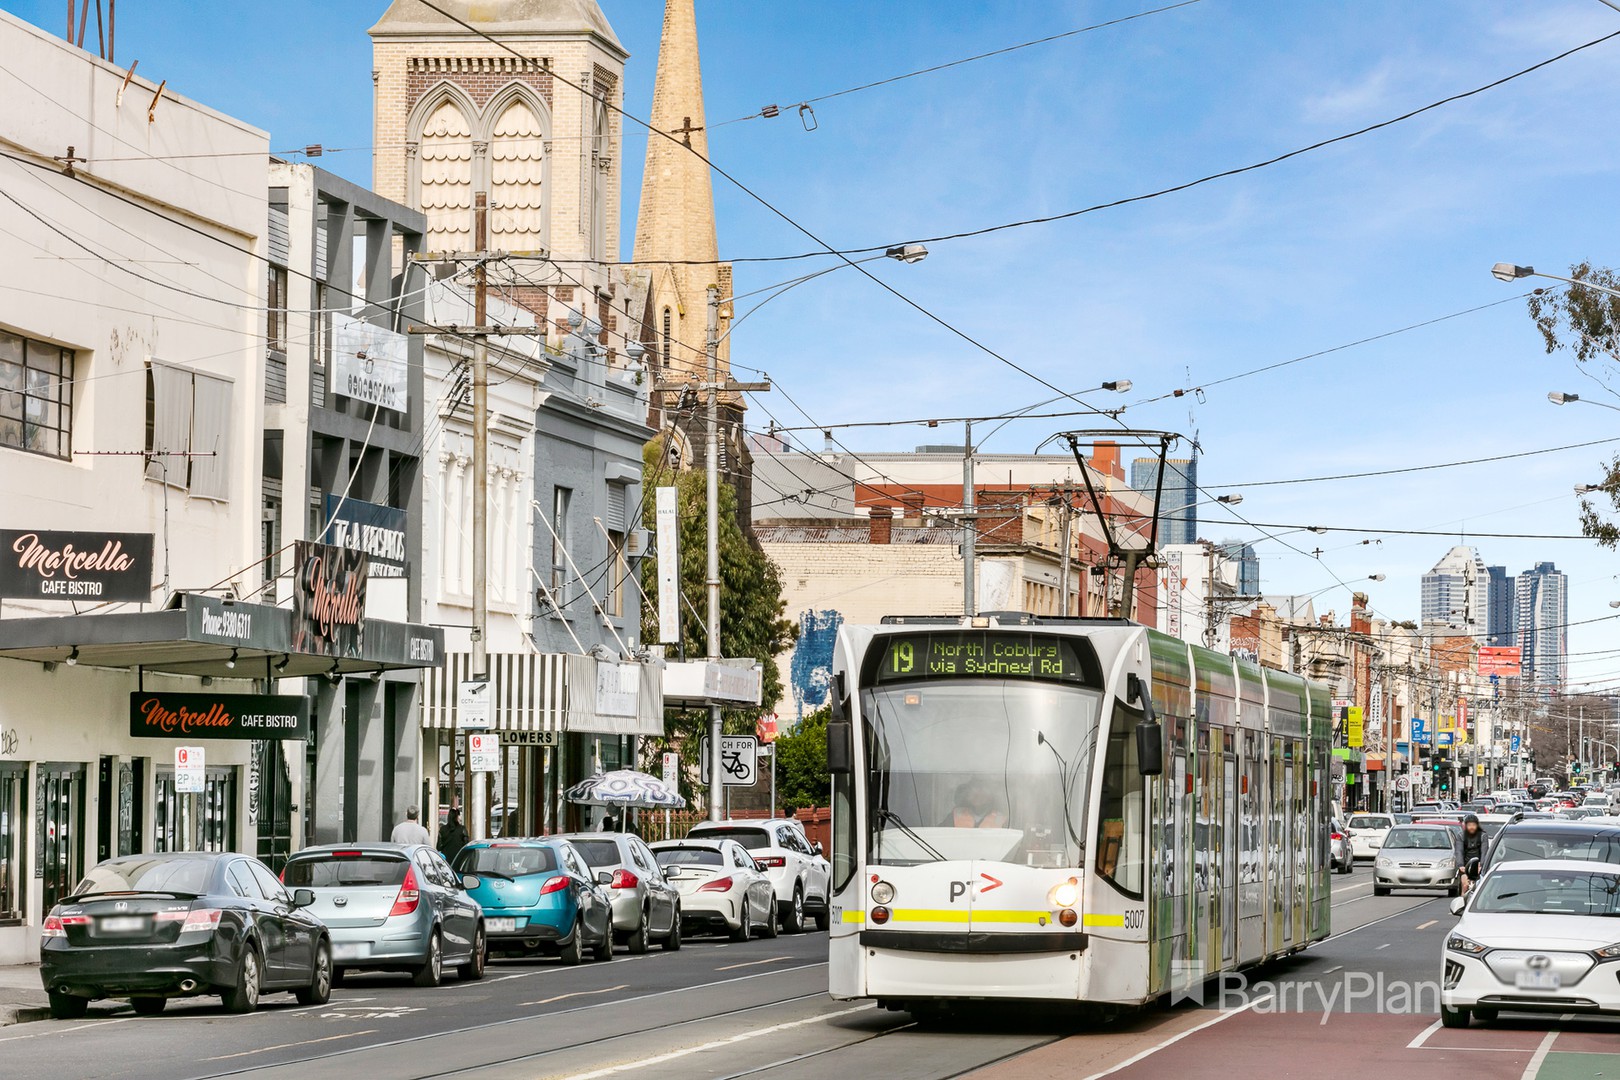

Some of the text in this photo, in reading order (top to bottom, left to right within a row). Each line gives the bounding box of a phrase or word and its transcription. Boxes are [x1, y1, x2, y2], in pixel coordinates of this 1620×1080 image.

[13, 533, 135, 579] Marcella
[663, 524, 673, 575] PIZZA
[41, 580, 103, 595] CAFE BISTRO
[1169, 564, 1180, 610] MEDICAL
[310, 556, 362, 643] Marcella
[664, 584, 675, 635] KEBAB
[202, 607, 222, 636] Phone:
[222, 611, 238, 638] 9380
[410, 637, 434, 662] CAFE BISTRO
[891, 641, 914, 672] 19
[934, 642, 1057, 657] North Coburg
[930, 659, 1063, 674] via Sydney Rd
[140, 698, 234, 733] Marcella
[241, 714, 298, 728] CAFE BISTRO
[1413, 722, 1421, 731] P
[736, 741, 753, 749] FOR
[472, 756, 483, 765] 2P
[177, 773, 190, 785] 2P
[1124, 909, 1145, 929] 5007
